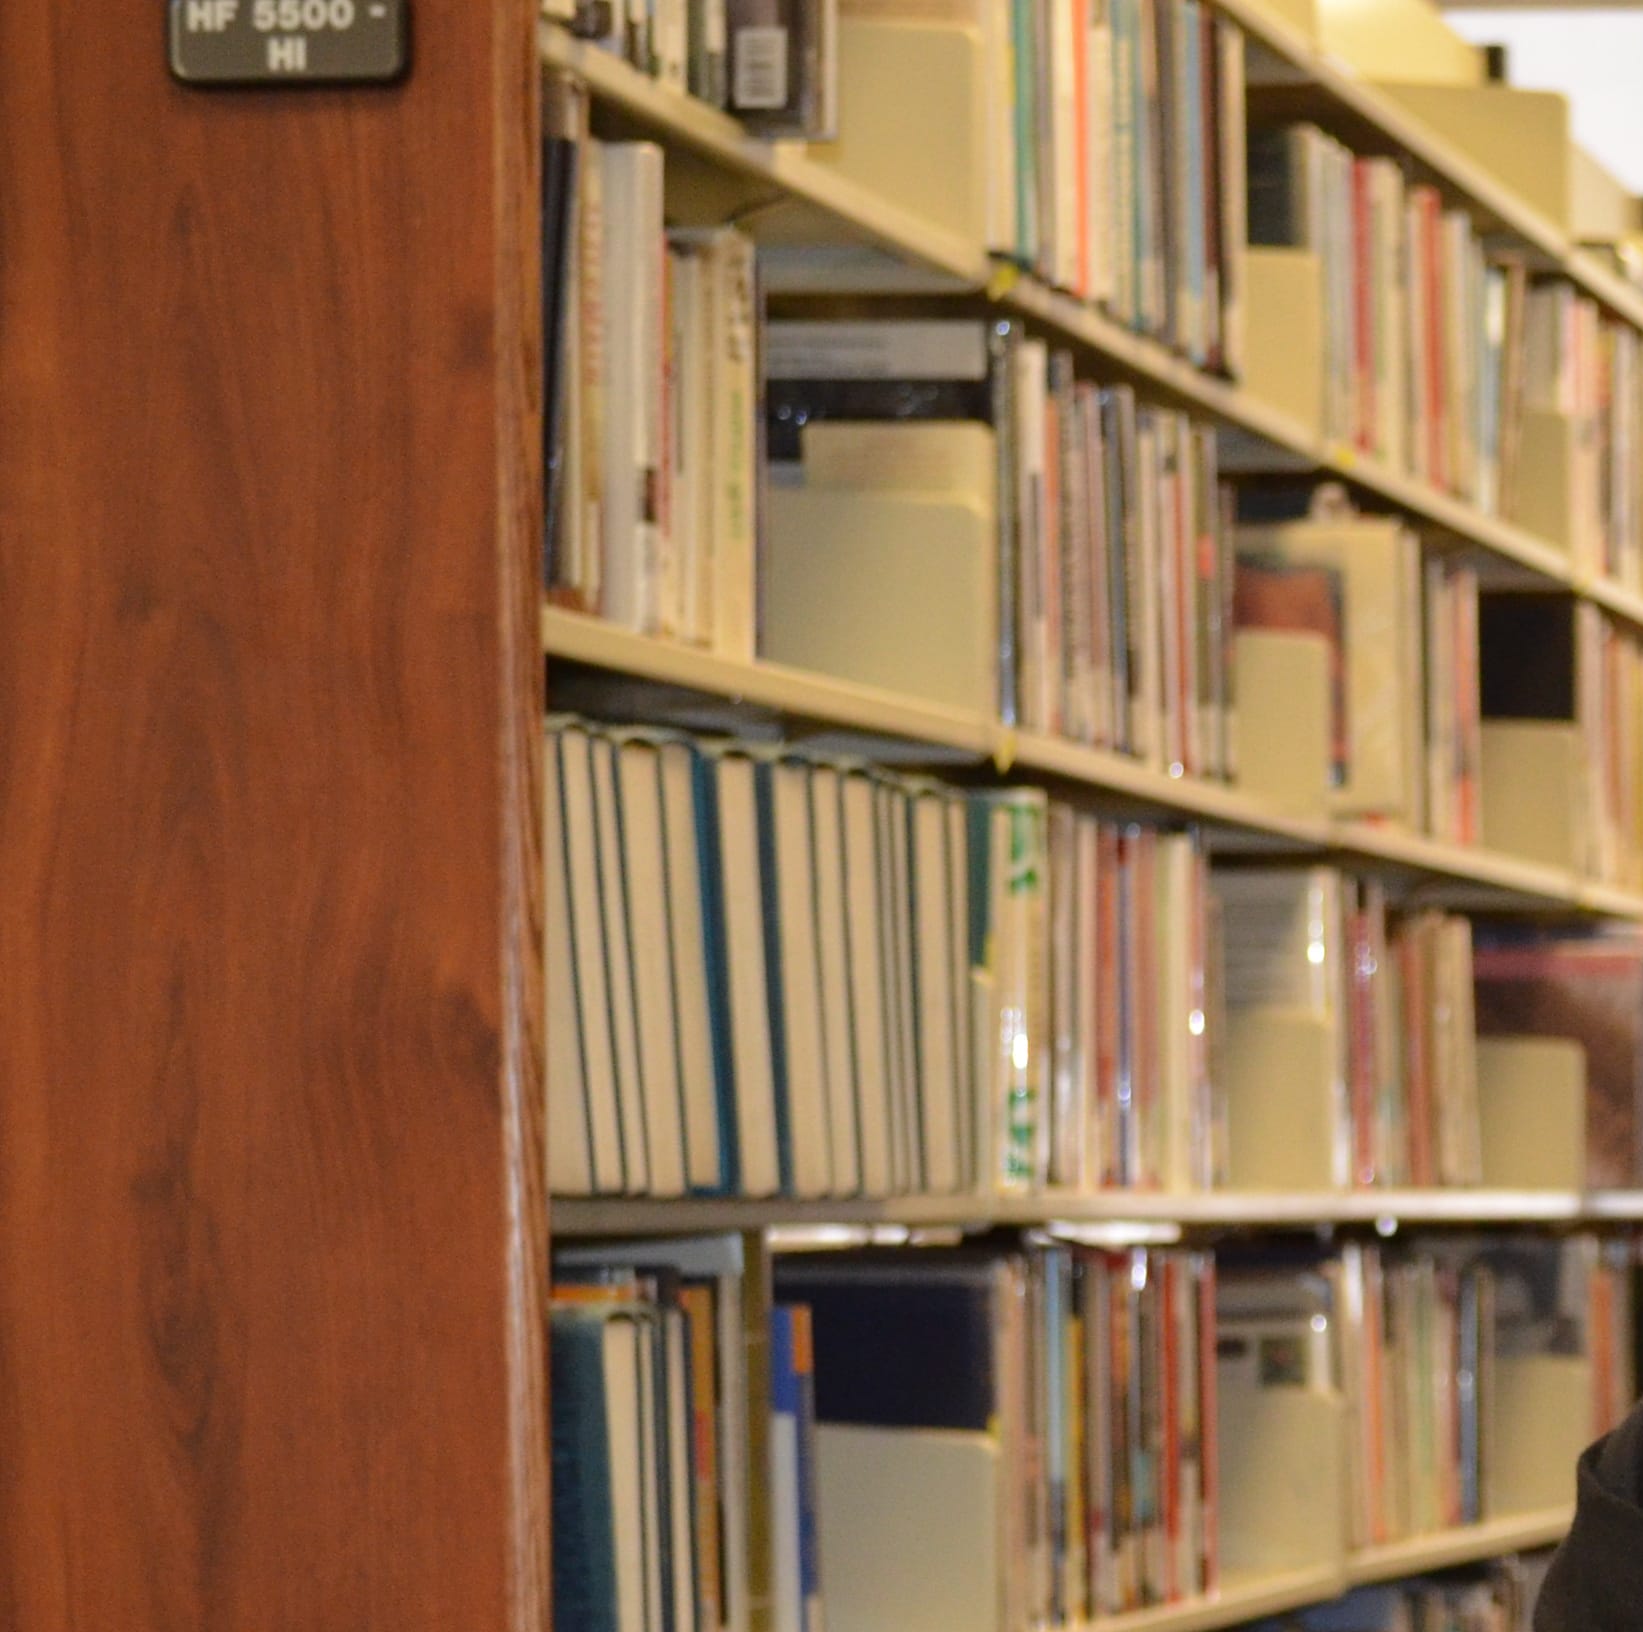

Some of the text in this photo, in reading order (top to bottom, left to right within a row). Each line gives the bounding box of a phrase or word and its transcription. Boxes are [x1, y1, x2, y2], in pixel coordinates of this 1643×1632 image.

[187, 0, 237, 32] HF
[253, 0, 355, 31] 5500
[267, 36, 308, 71] HI
